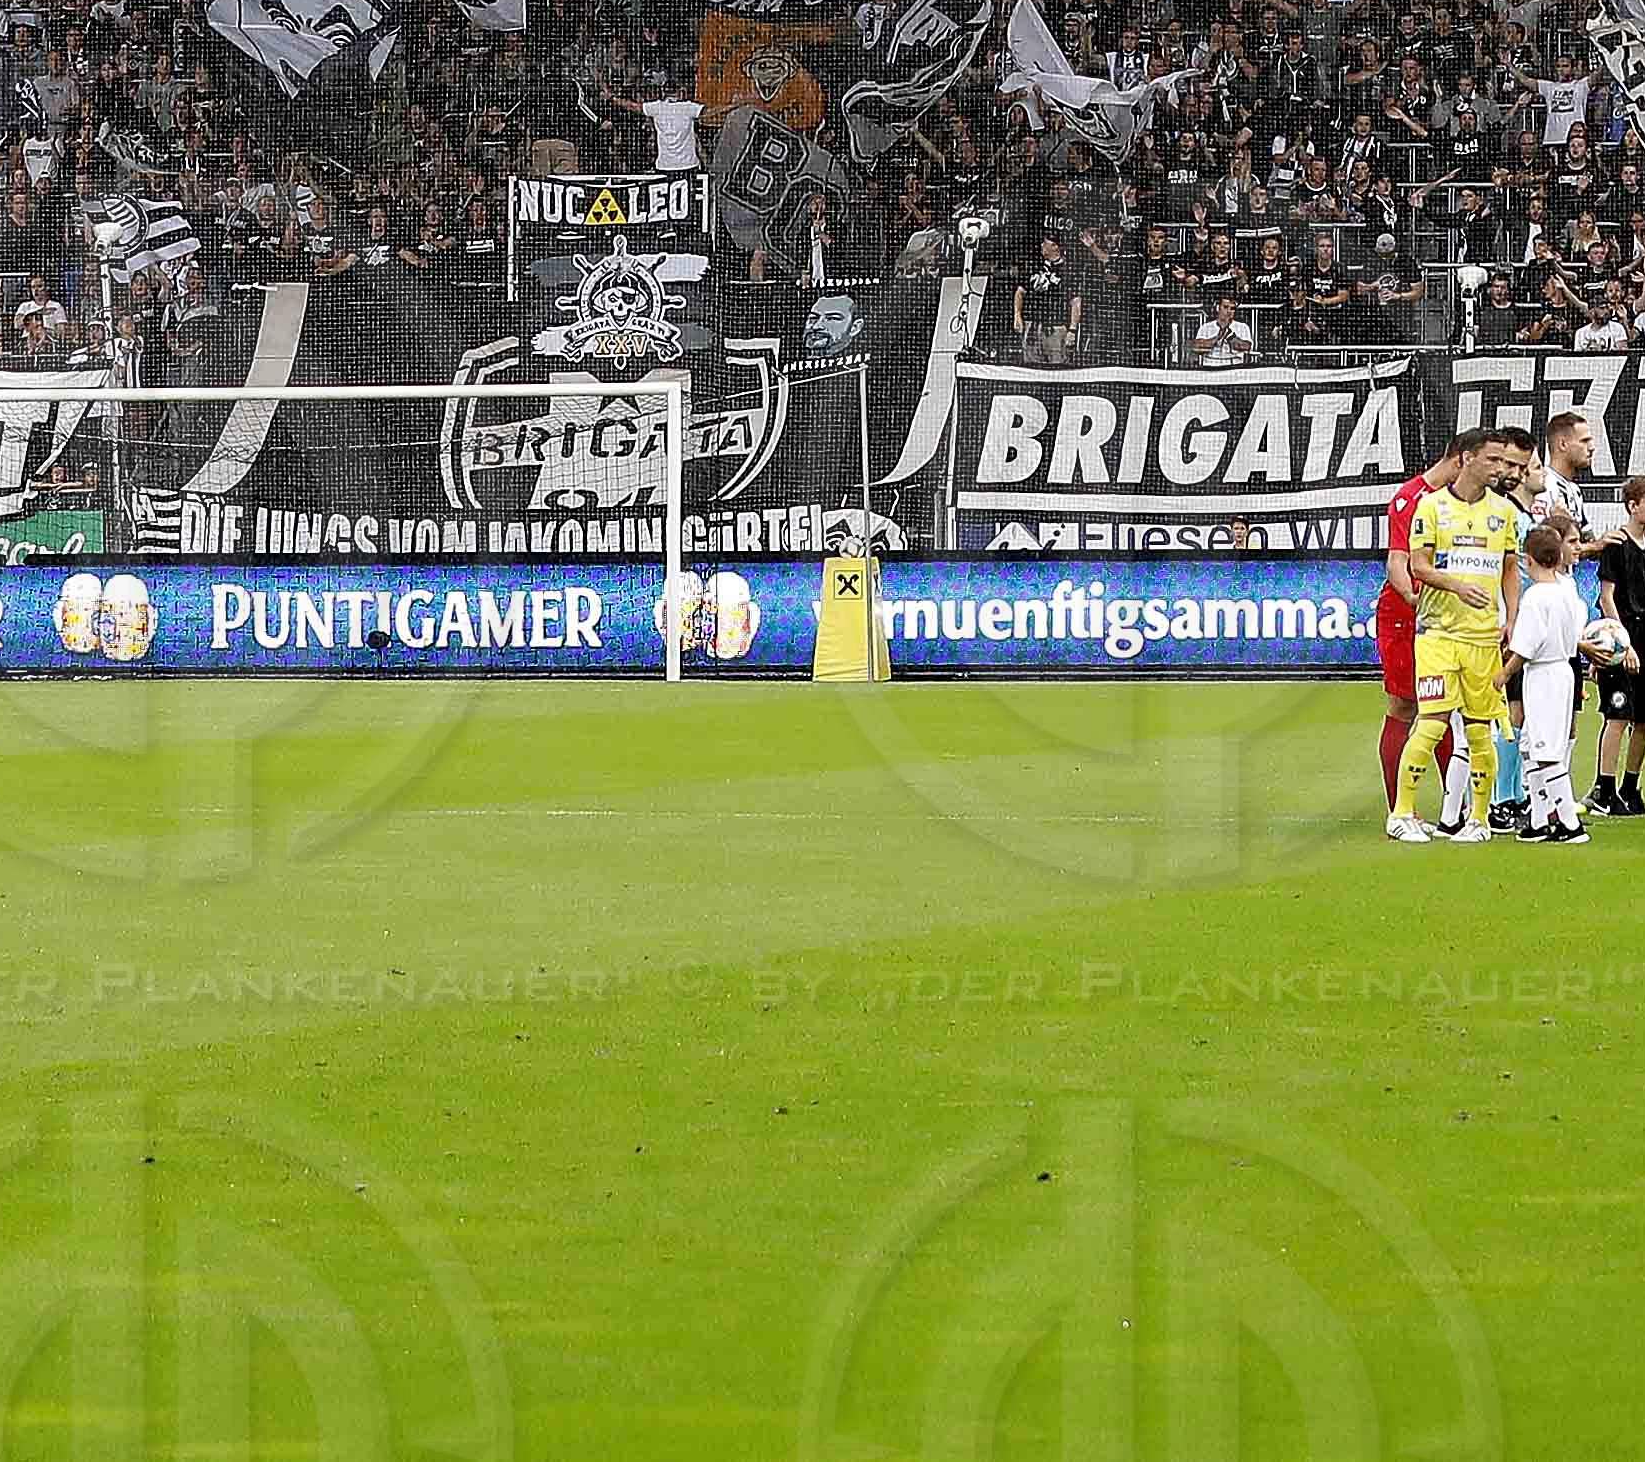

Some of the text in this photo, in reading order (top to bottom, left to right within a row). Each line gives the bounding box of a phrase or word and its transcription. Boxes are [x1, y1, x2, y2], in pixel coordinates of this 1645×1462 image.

[594, 333, 650, 357] XXV
[974, 387, 1408, 485] BRIGATA
[212, 582, 605, 650] PUNTIGAMER
